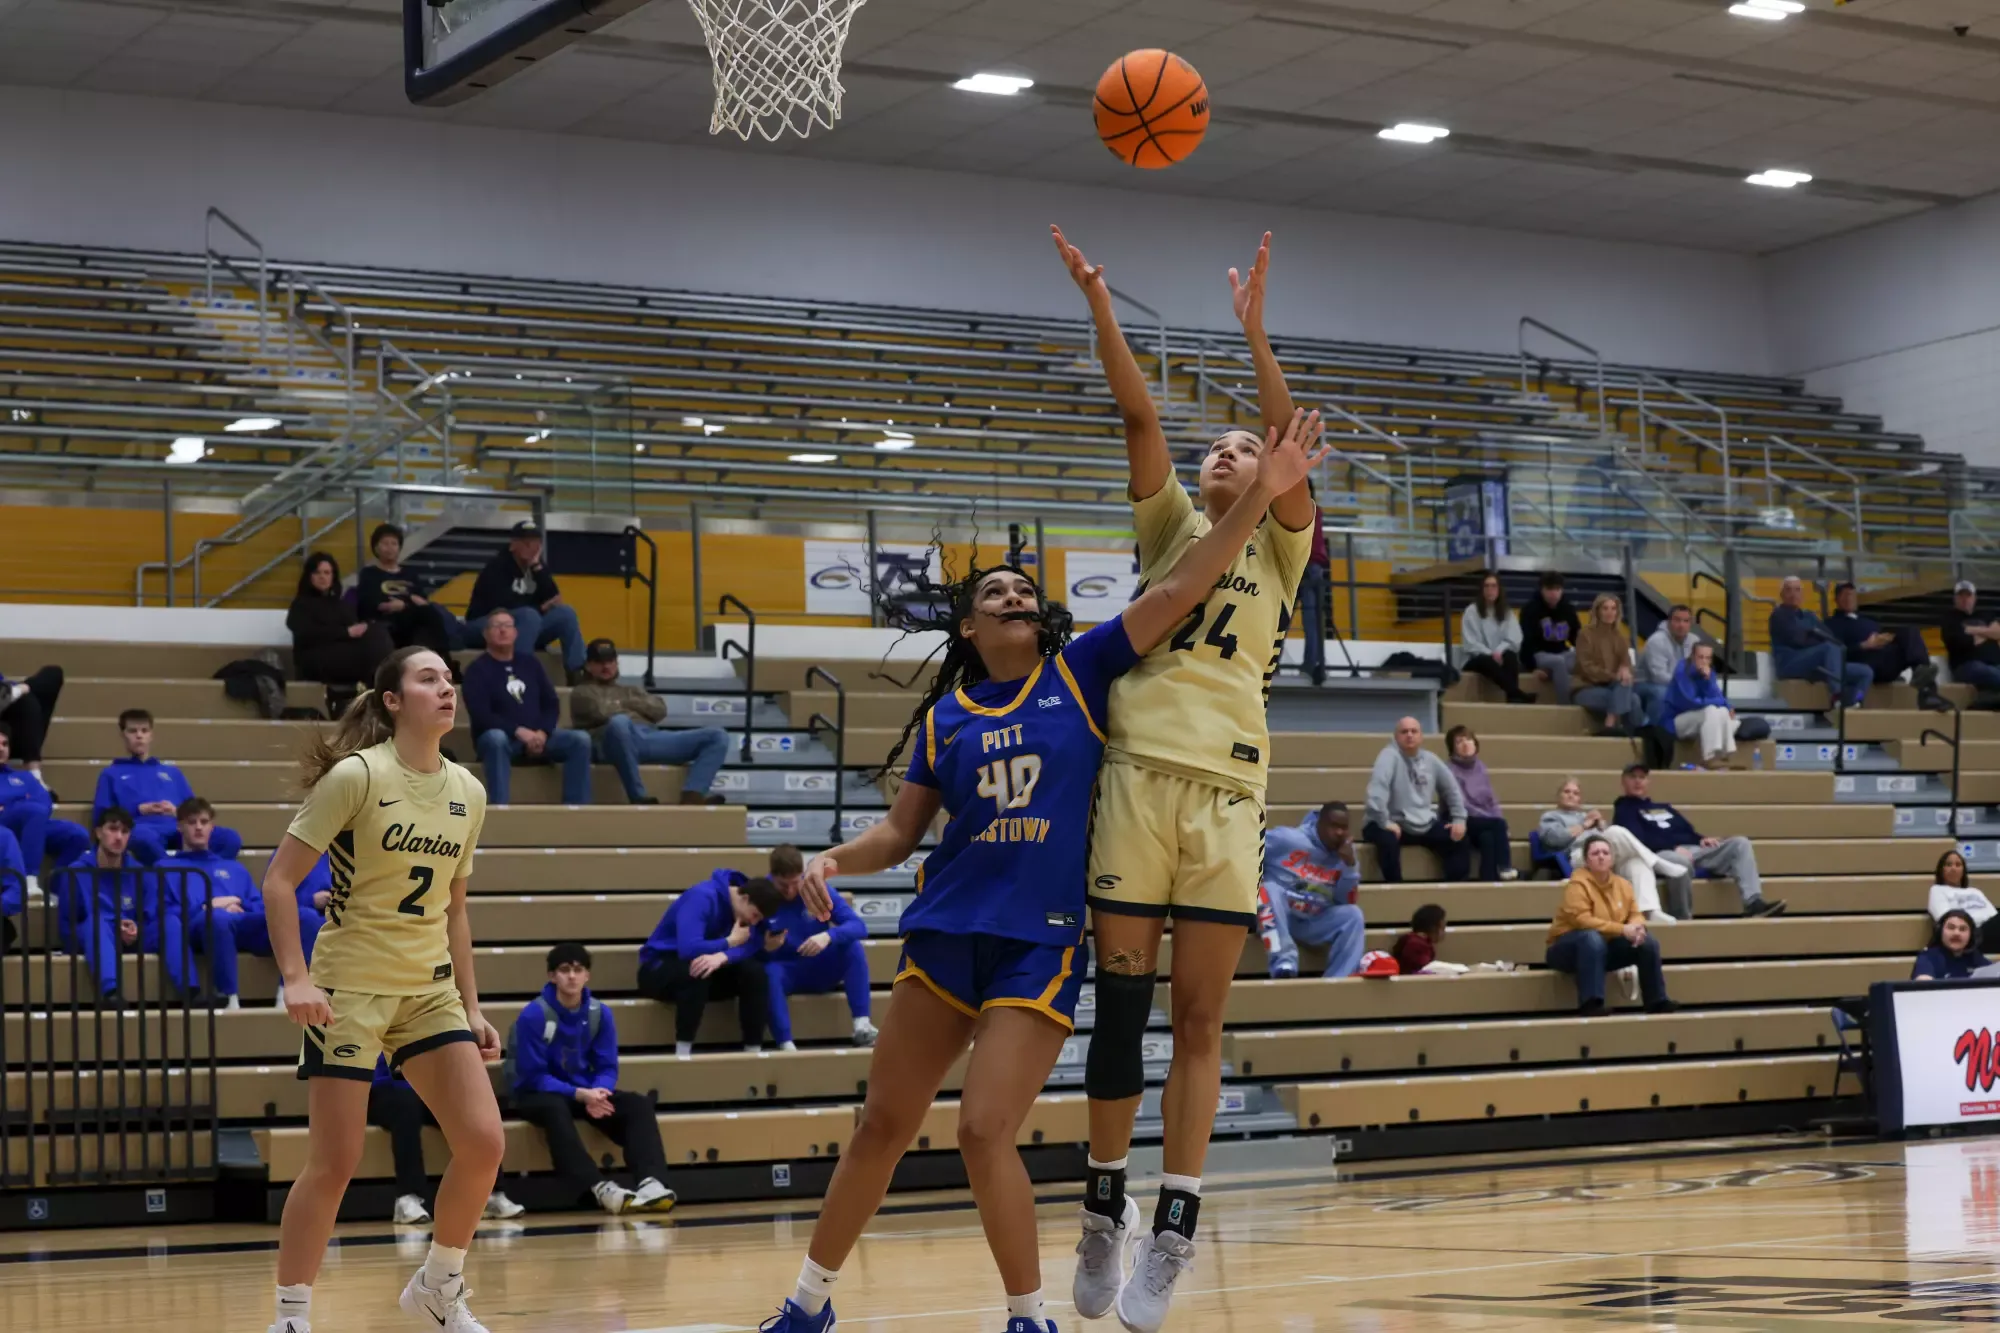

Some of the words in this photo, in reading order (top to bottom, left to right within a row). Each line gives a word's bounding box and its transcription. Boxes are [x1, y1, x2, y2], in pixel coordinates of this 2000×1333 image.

[1169, 602, 1238, 660] 24
[981, 723, 1023, 753] PITT
[976, 753, 1042, 819] 40
[381, 823, 461, 858] Clarion
[397, 865, 434, 917] 2
